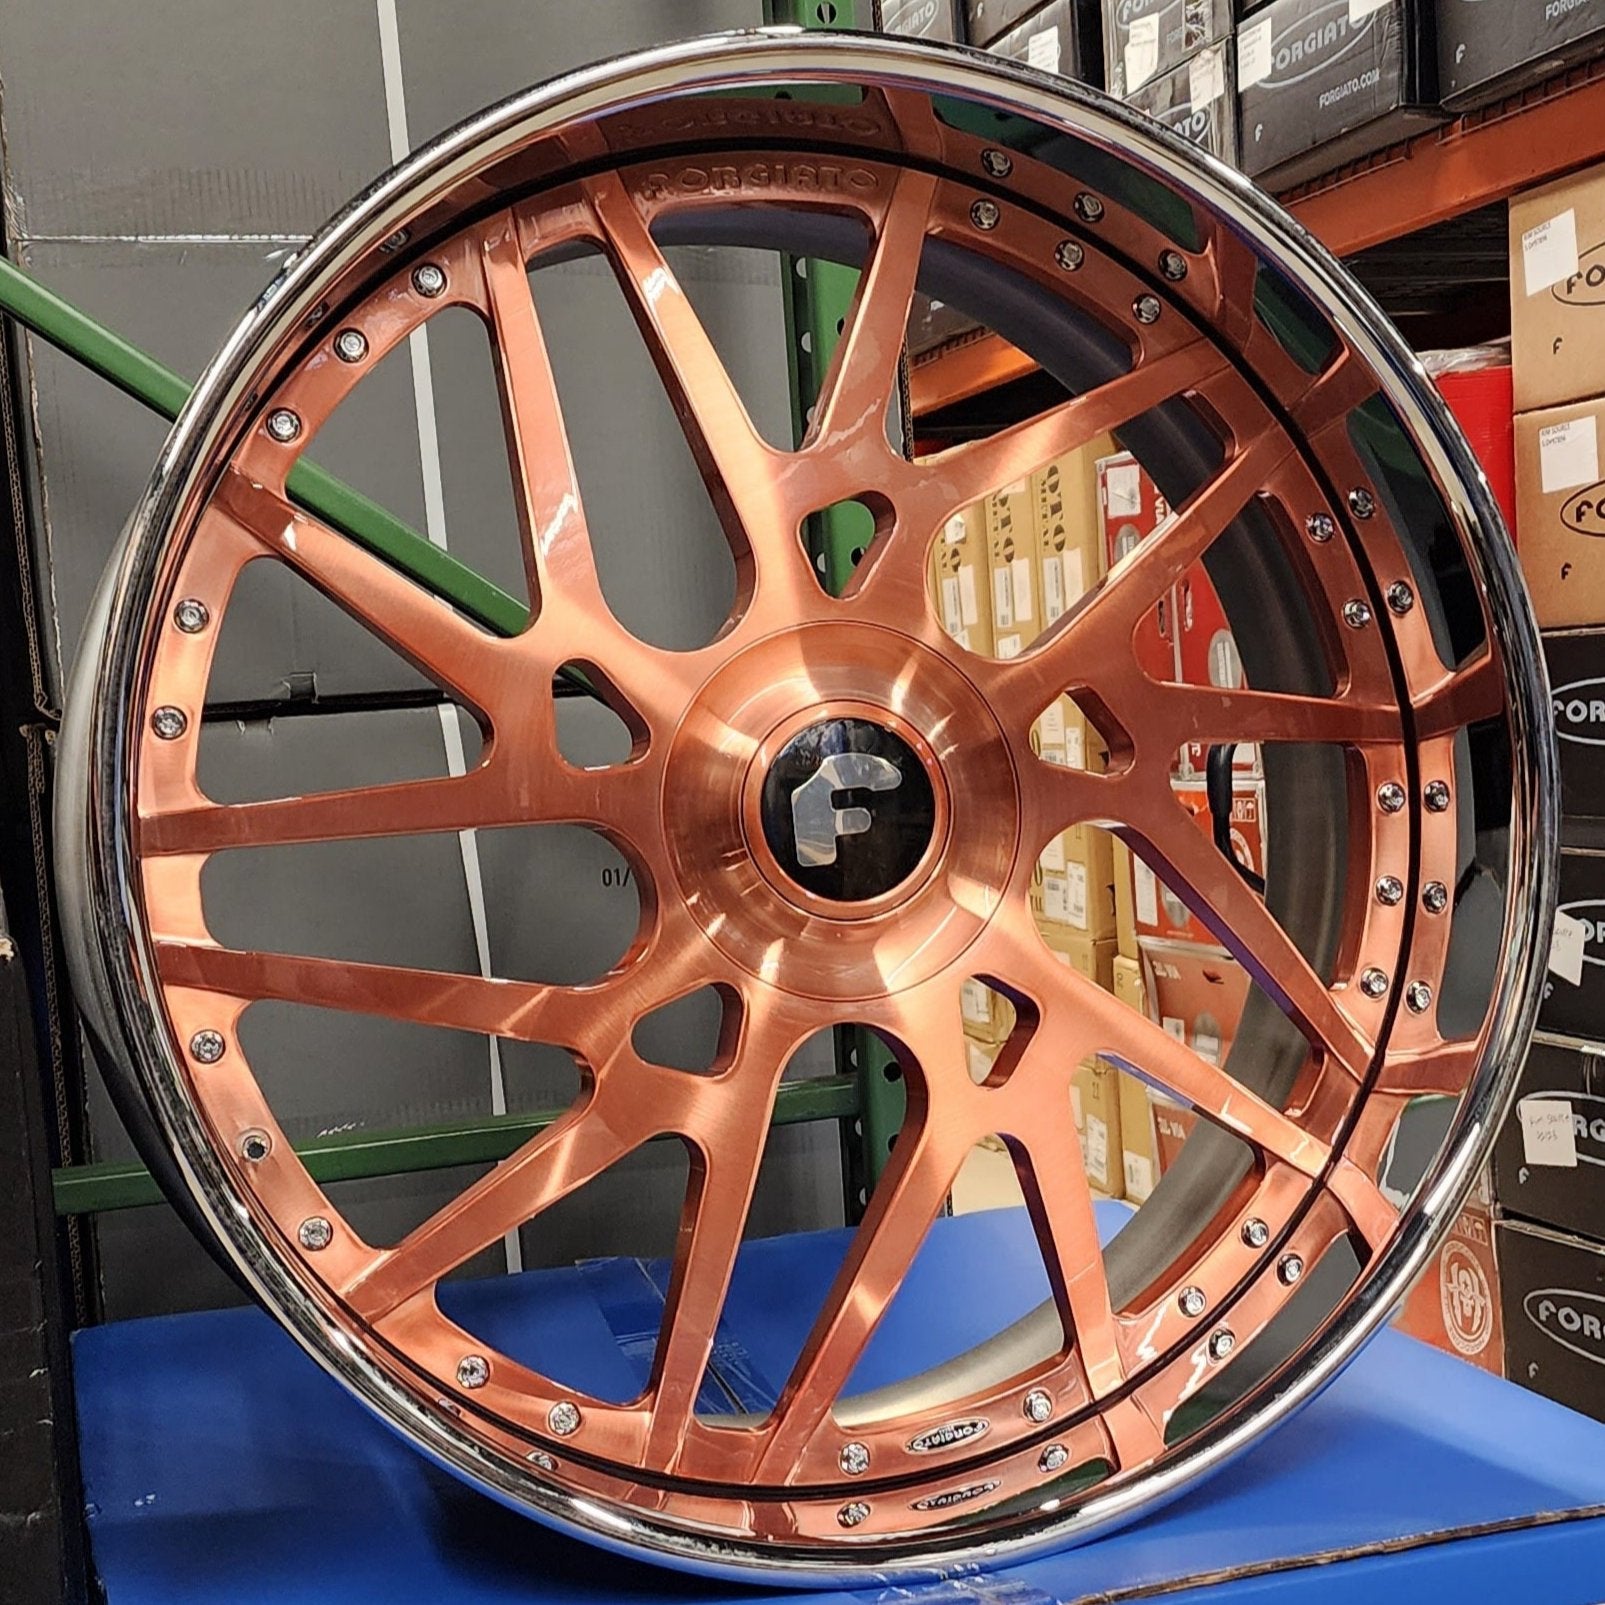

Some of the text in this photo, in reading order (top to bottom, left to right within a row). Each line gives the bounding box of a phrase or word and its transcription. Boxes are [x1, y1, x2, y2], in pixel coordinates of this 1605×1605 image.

[1271, 13, 1367, 70] ORGIAT
[1318, 67, 1380, 109] FORGIATO.COM
[641, 162, 880, 197] FORGIATO
[791, 752, 903, 868] F
[1538, 1299, 1605, 1341] FOR
